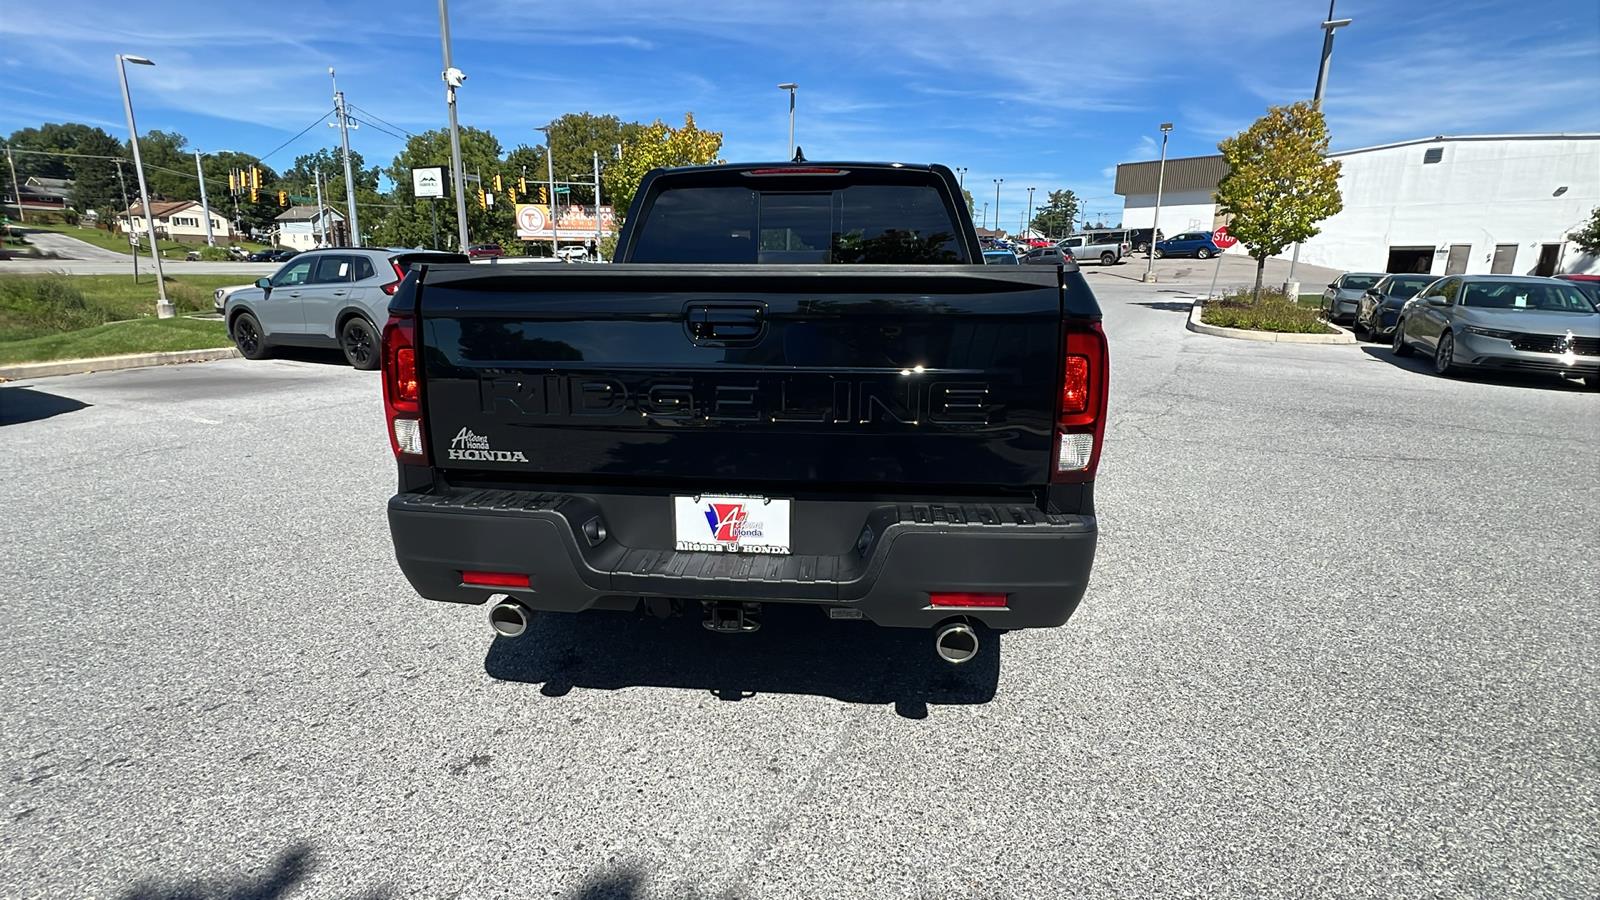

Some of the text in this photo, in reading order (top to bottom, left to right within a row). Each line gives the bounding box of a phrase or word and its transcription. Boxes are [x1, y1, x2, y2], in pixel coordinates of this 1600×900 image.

[480, 372, 992, 425] RIDGELINE
[447, 449, 529, 462] HONDA
[734, 528, 762, 537] Honda
[676, 541, 791, 555] Altoona HONDA
